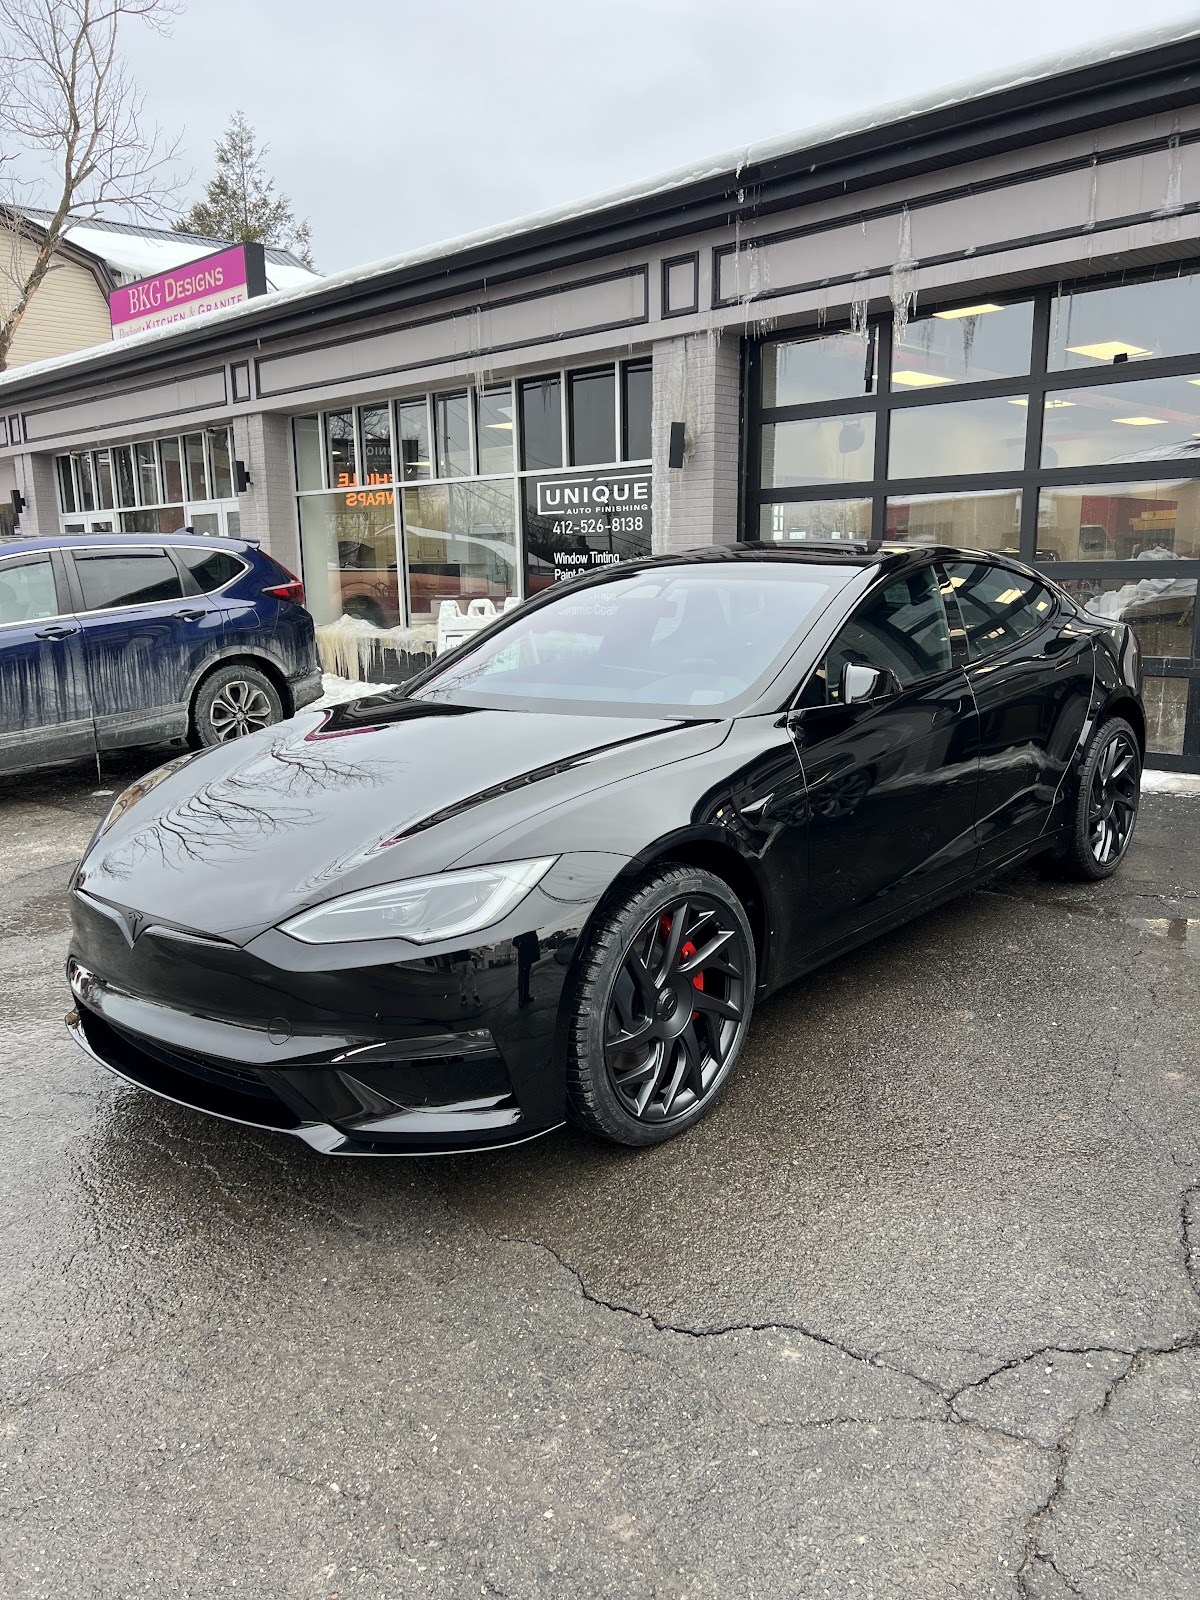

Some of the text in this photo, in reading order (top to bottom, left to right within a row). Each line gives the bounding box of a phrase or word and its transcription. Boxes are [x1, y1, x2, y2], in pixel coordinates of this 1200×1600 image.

[128, 281, 161, 314] BKG
[545, 482, 648, 505] UNIQUE
[566, 504, 648, 515] AUTO FINISHING
[552, 516, 643, 534] 412-526-8138
[553, 551, 619, 565] Window Tinting
